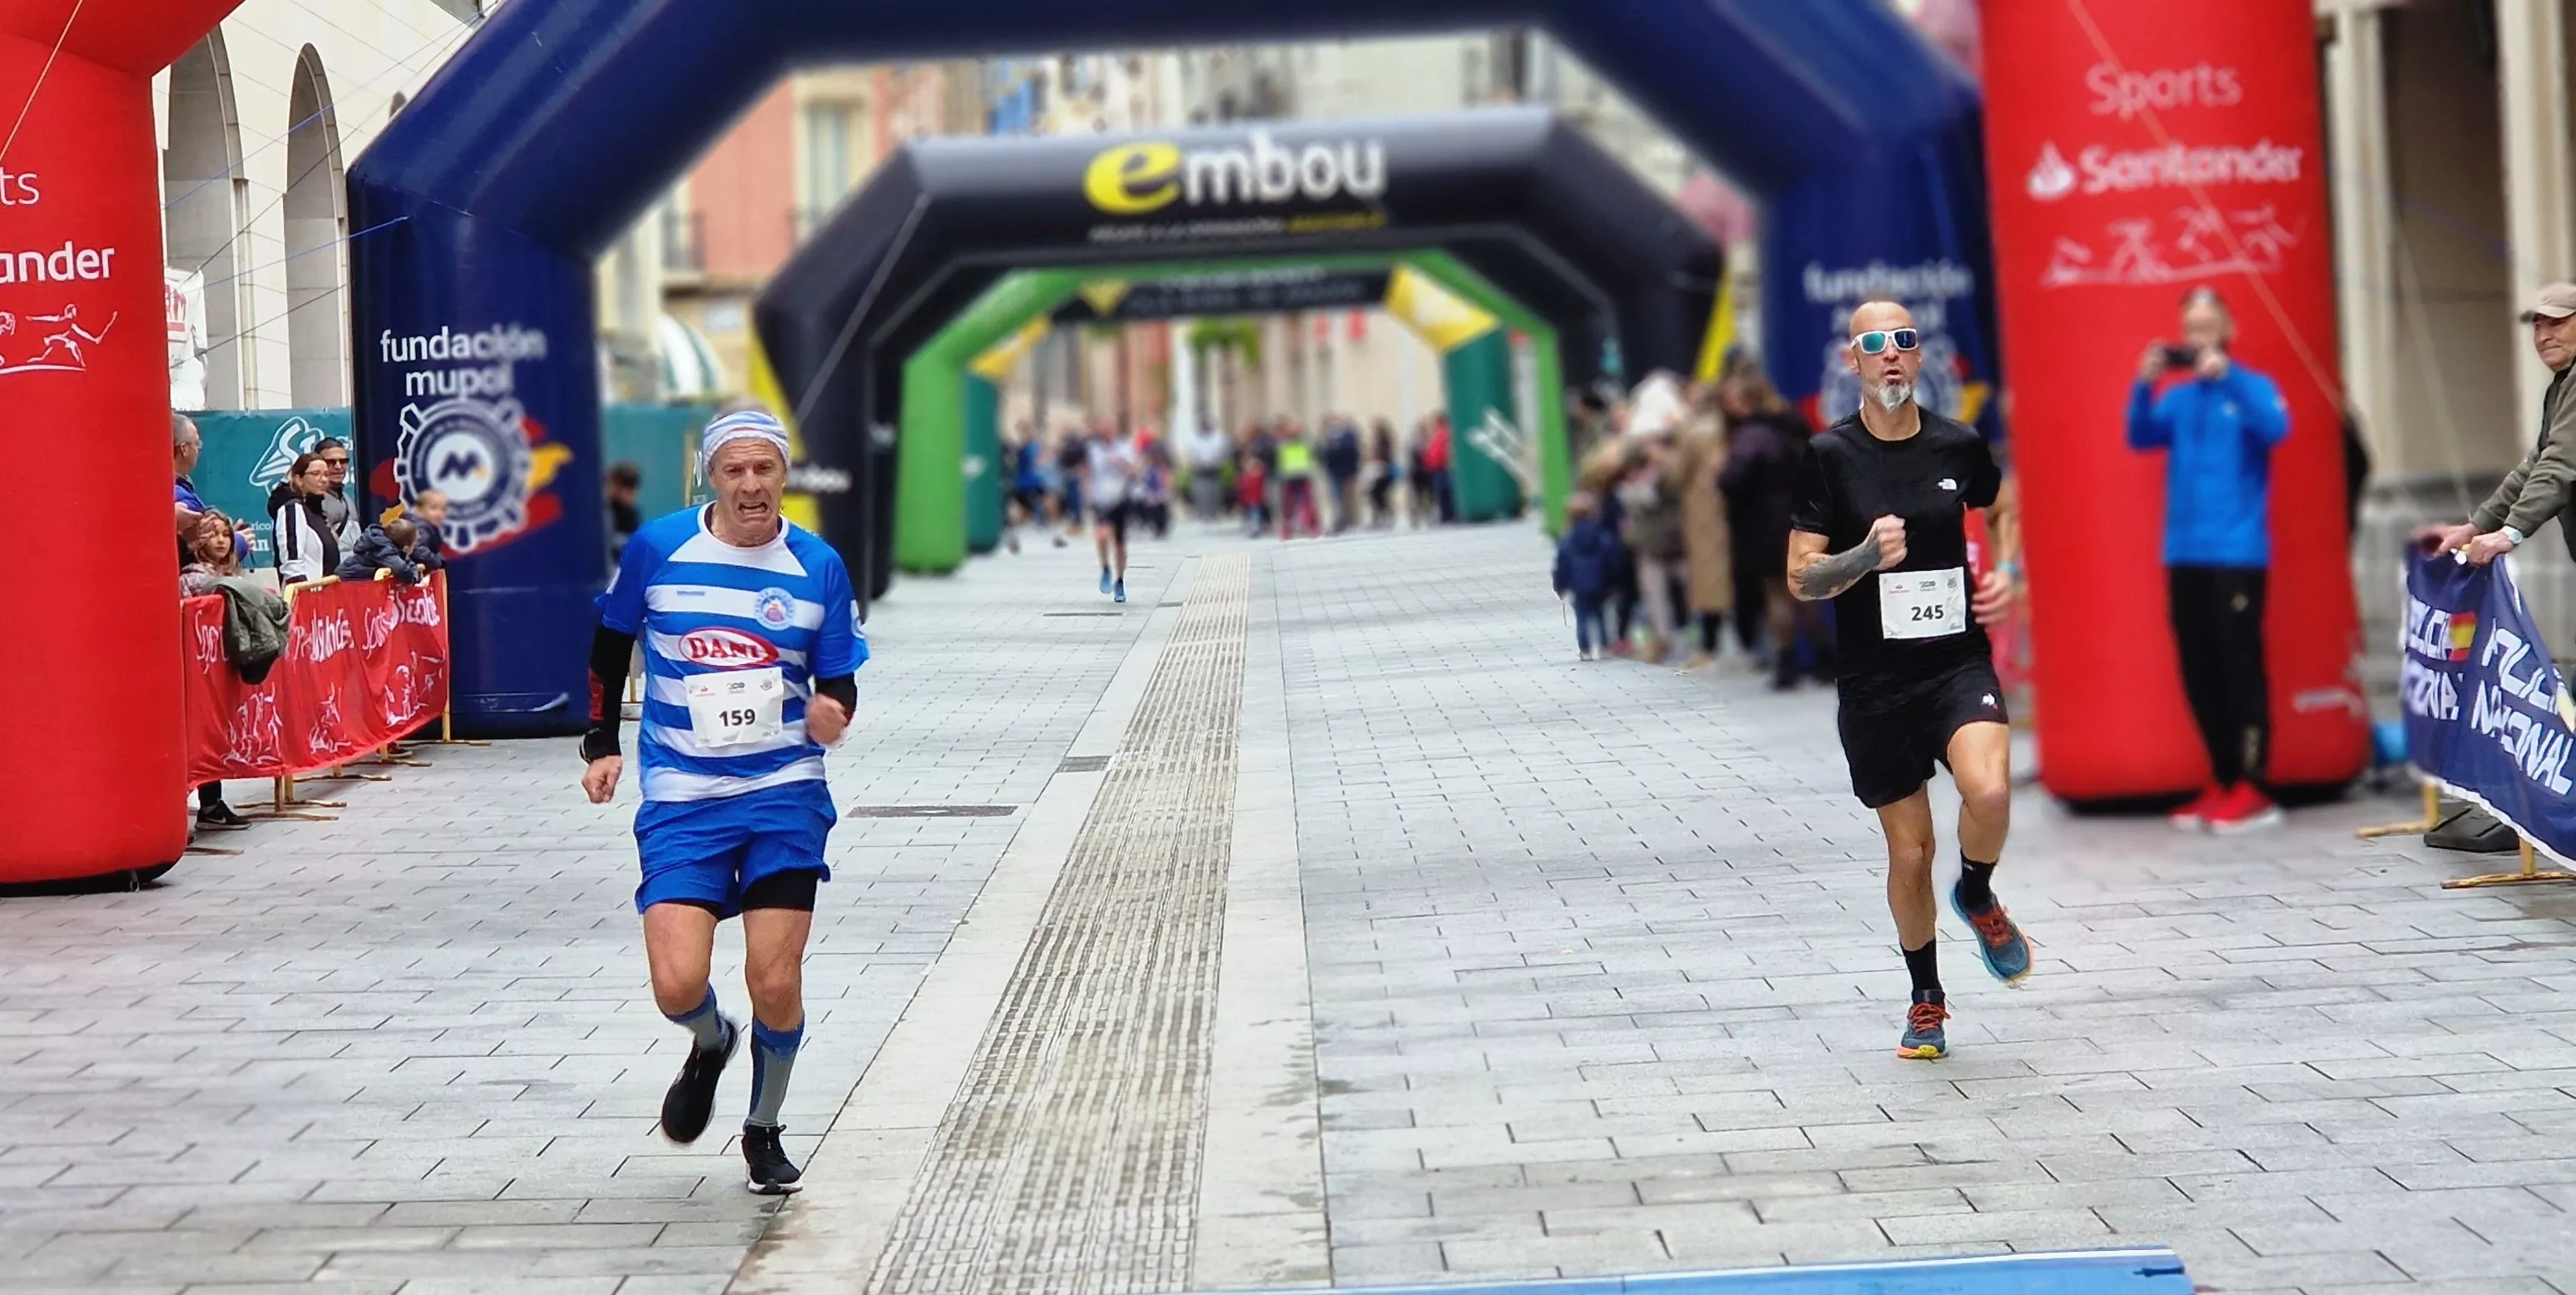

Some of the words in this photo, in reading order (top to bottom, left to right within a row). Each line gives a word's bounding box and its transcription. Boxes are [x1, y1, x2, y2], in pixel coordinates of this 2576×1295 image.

[2085, 62, 2244, 121] Sports
[1084, 129, 1386, 214] embou
[2080, 136, 2303, 193] Santander
[380, 325, 547, 362] fundación
[1910, 604, 1944, 622] 245
[719, 708, 756, 727] 159
